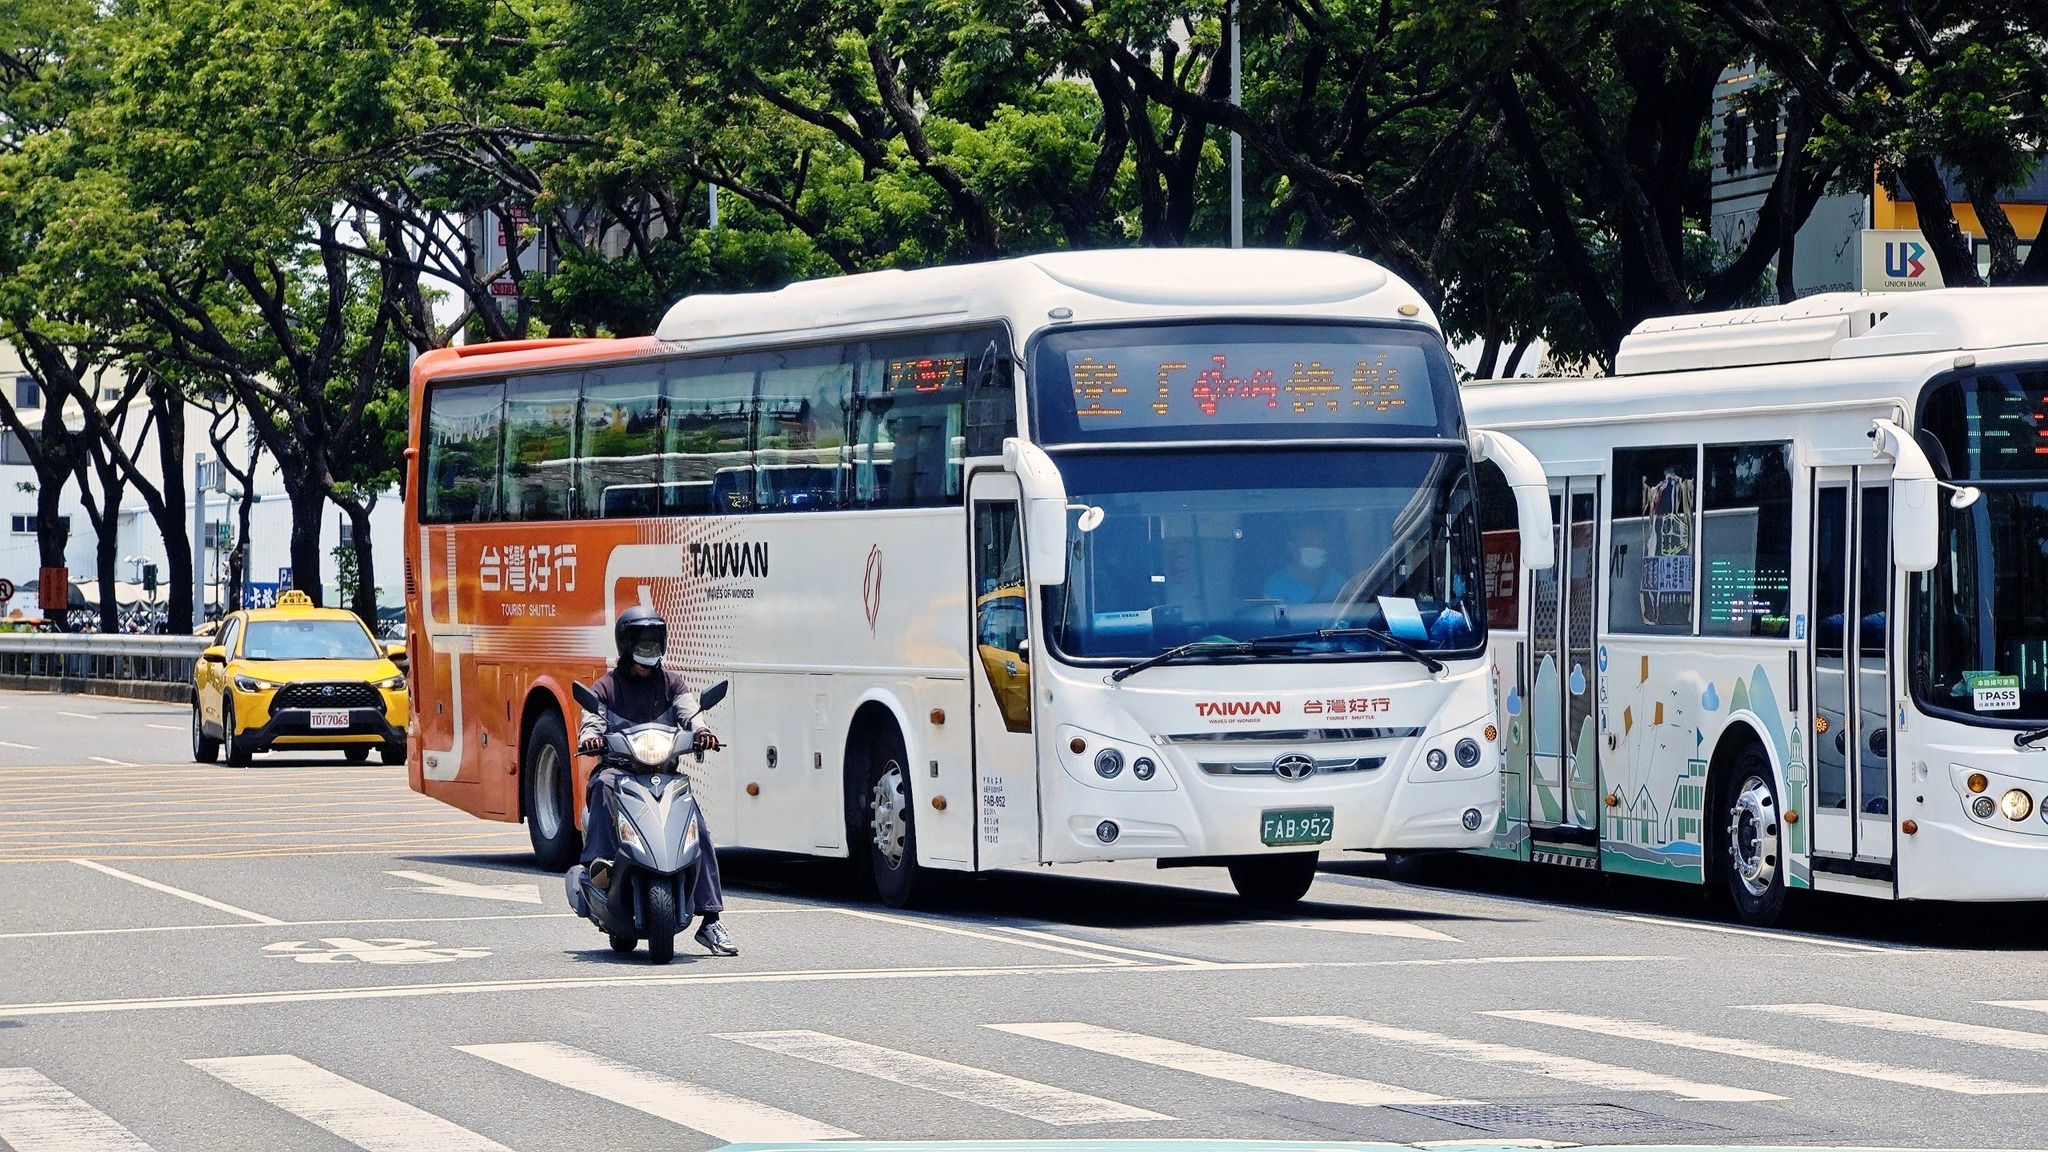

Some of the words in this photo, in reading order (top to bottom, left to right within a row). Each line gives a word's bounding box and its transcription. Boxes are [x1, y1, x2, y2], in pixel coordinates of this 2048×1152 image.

[690, 541, 768, 578] TAIWAN
[480, 544, 577, 592] 台灣好行
[706, 589, 722, 599] WAVES
[723, 589, 731, 598] OF
[732, 588, 754, 599] WONDER
[501, 603, 526, 616] TOURIST
[528, 604, 556, 617] SHUTTLE
[1978, 691, 2016, 700] TPASS
[1195, 701, 1281, 717] TAIWAN
[1303, 697, 1390, 714] 台灣好行
[984, 795, 1005, 807] FAB-952
